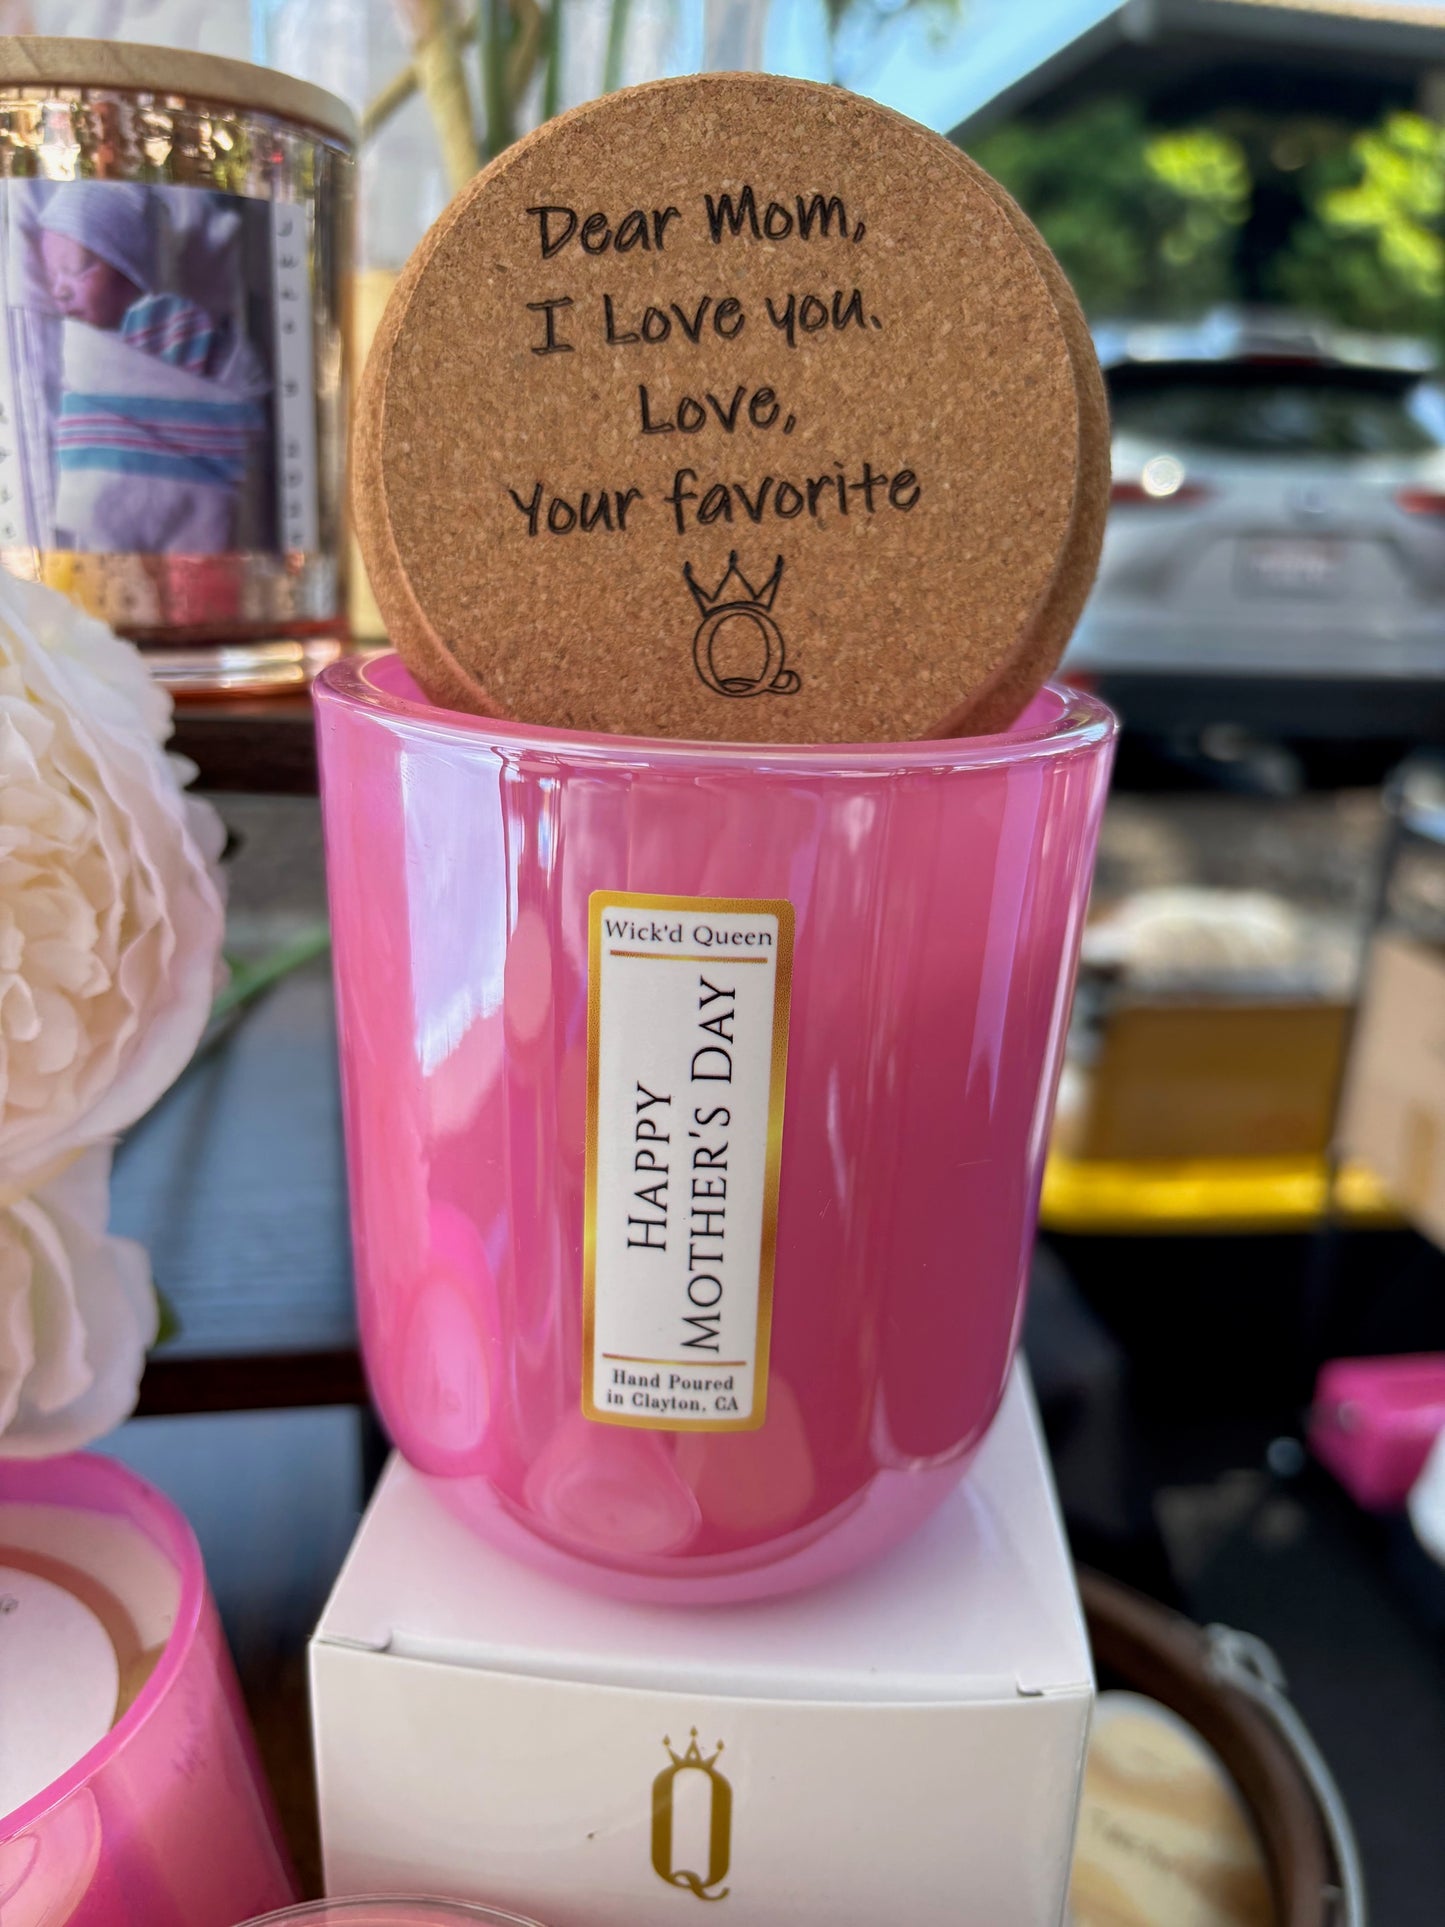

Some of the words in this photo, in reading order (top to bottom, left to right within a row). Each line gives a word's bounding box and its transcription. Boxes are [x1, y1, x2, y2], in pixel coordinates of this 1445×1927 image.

[526, 205, 681, 260] Dear
[704, 185, 866, 243] Mom,
[526, 296, 573, 355] I
[603, 293, 745, 346] Love
[765, 288, 883, 348] you.
[638, 384, 797, 434] Love,
[508, 483, 642, 536] Your
[664, 461, 921, 534] favorite
[604, 918, 682, 943] Wick'd
[692, 925, 773, 947] Queen
[690, 974, 736, 1084] DAY
[627, 1080, 672, 1251] HAPPY
[680, 1106, 731, 1354] MOTHER'S
[606, 1389, 624, 1405] in
[631, 1391, 707, 1412] Clayton,
[714, 1396, 739, 1411] CA
[612, 1368, 661, 1388] Hand
[668, 1373, 734, 1391] Poured
